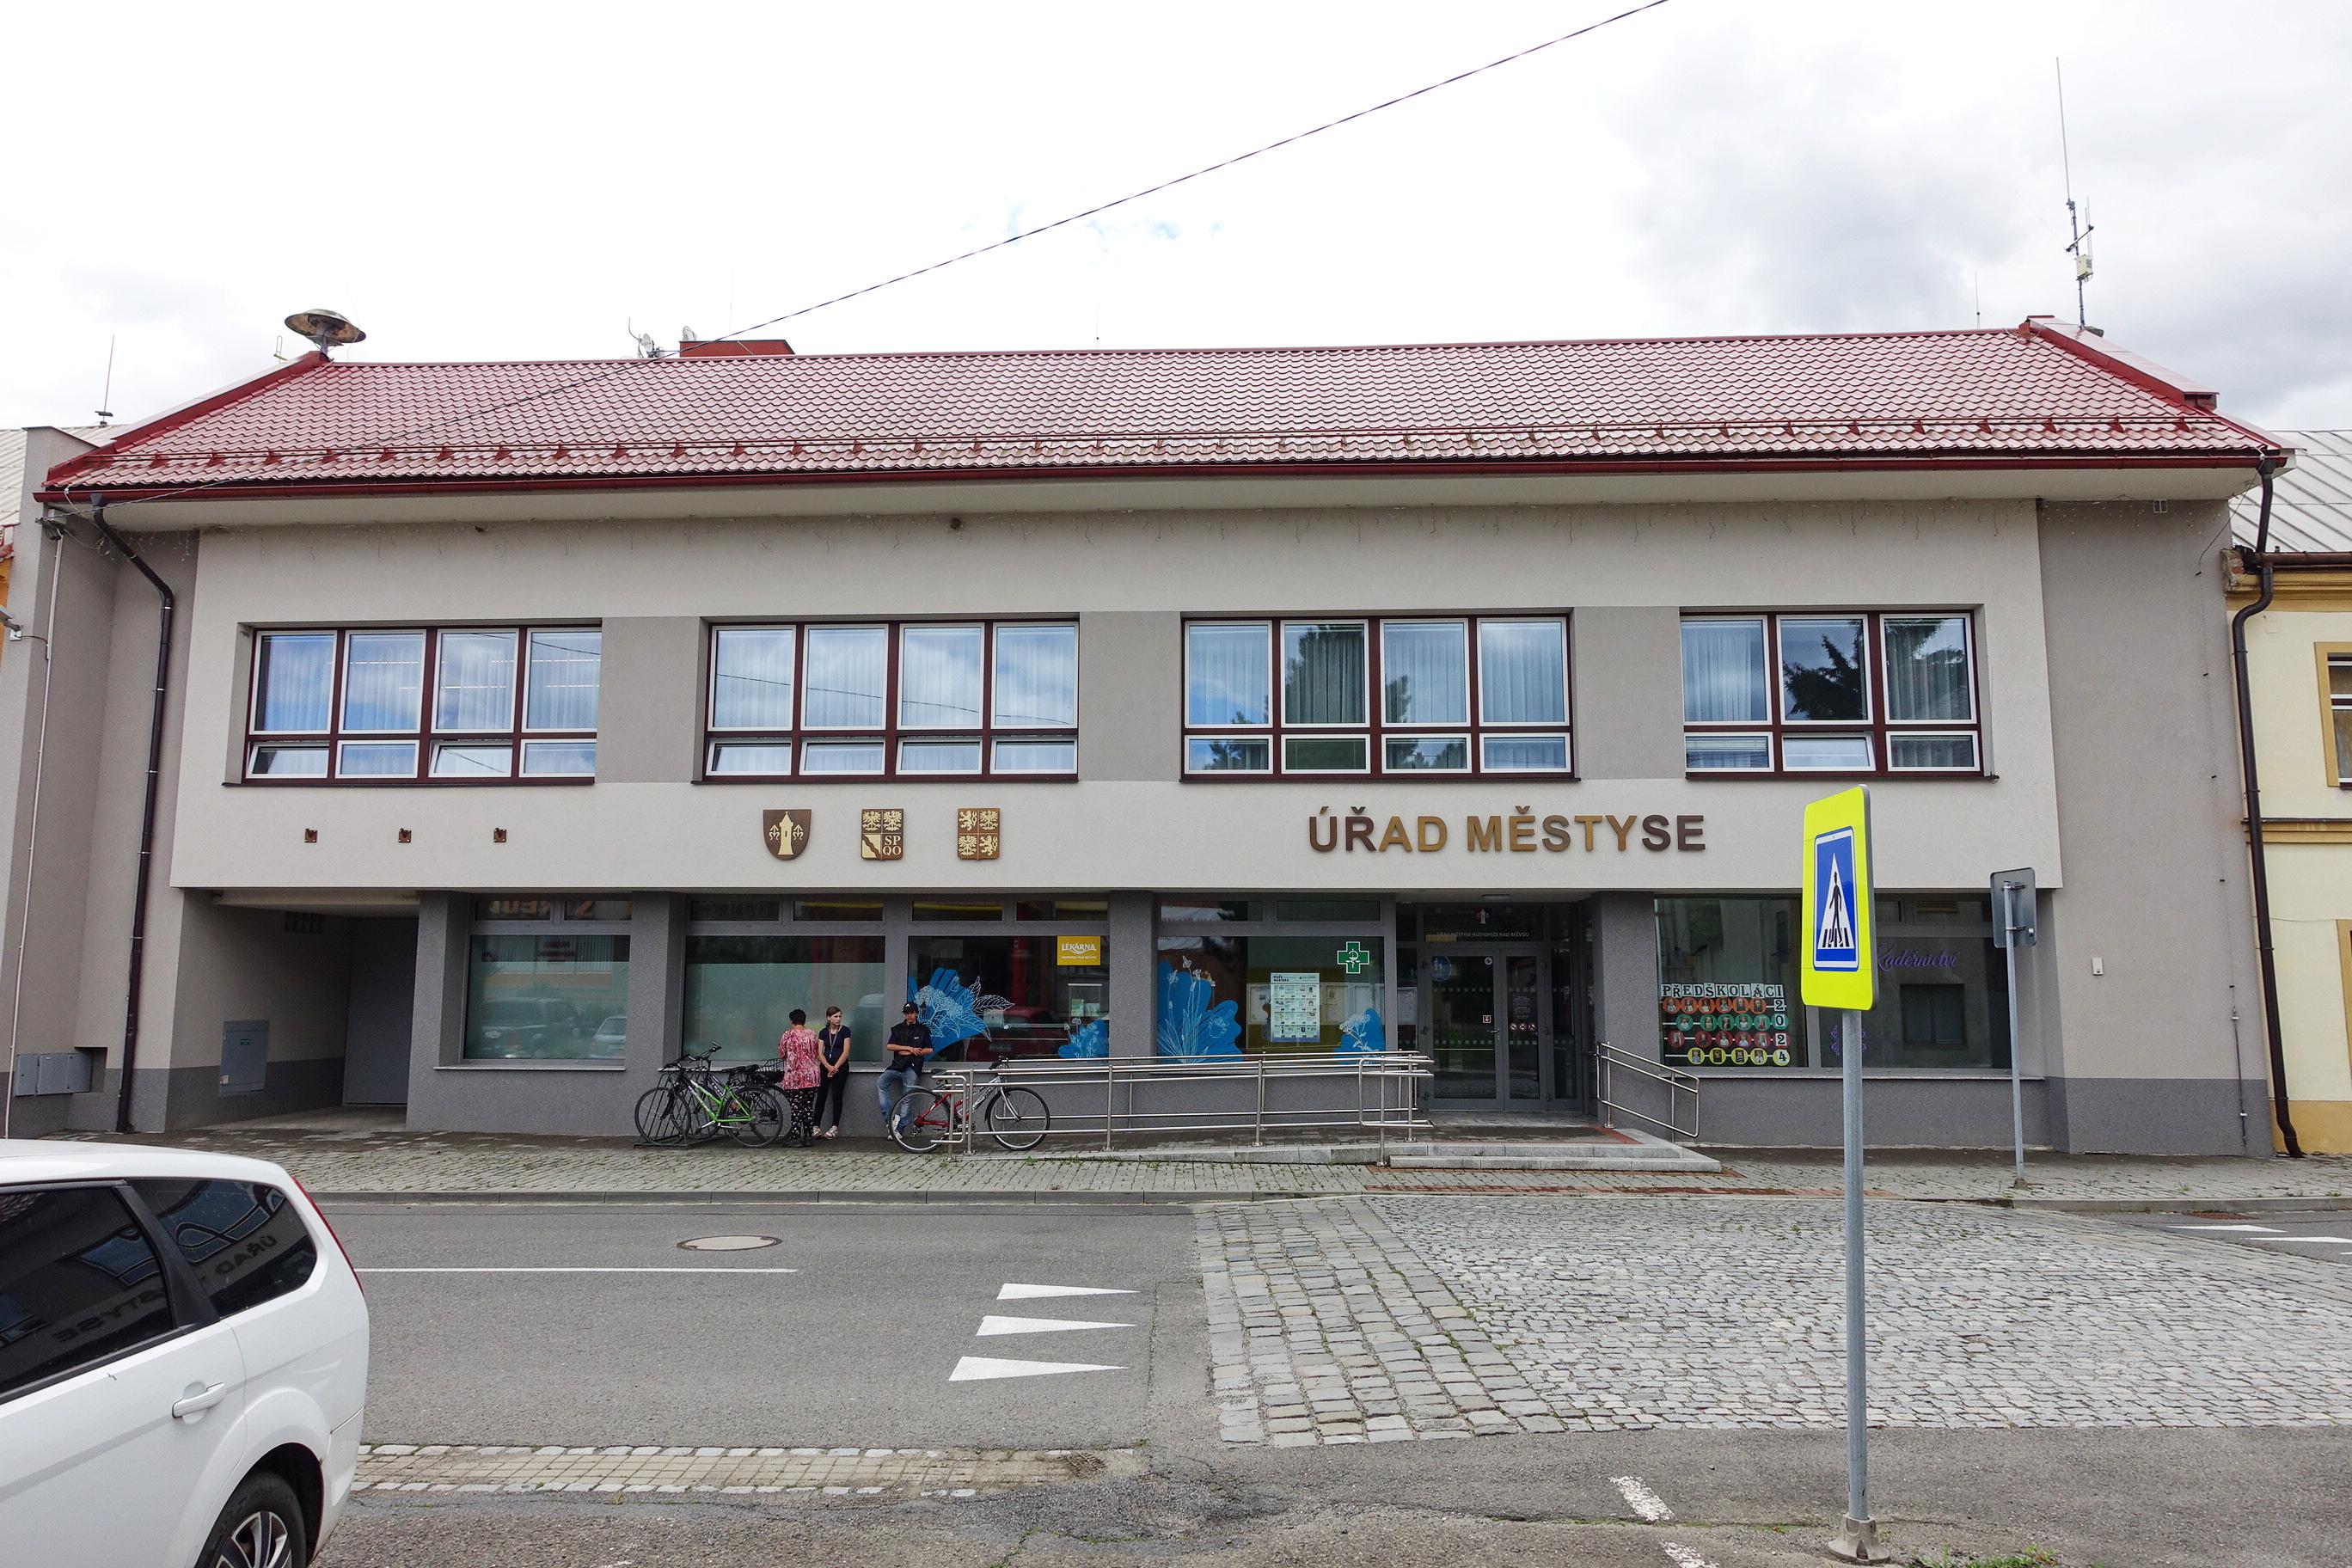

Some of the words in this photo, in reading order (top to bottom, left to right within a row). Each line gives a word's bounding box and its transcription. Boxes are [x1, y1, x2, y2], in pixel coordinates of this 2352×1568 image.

[1308, 805, 1448, 853] ÚŘAD
[1467, 805, 1706, 852] MĚSTYSE
[885, 836, 901, 845] SP
[883, 846, 902, 855] QO
[1061, 942, 1097, 954] LÉKÁRNA
[1662, 983, 1784, 998] PŘEDŠKOLÁCI
